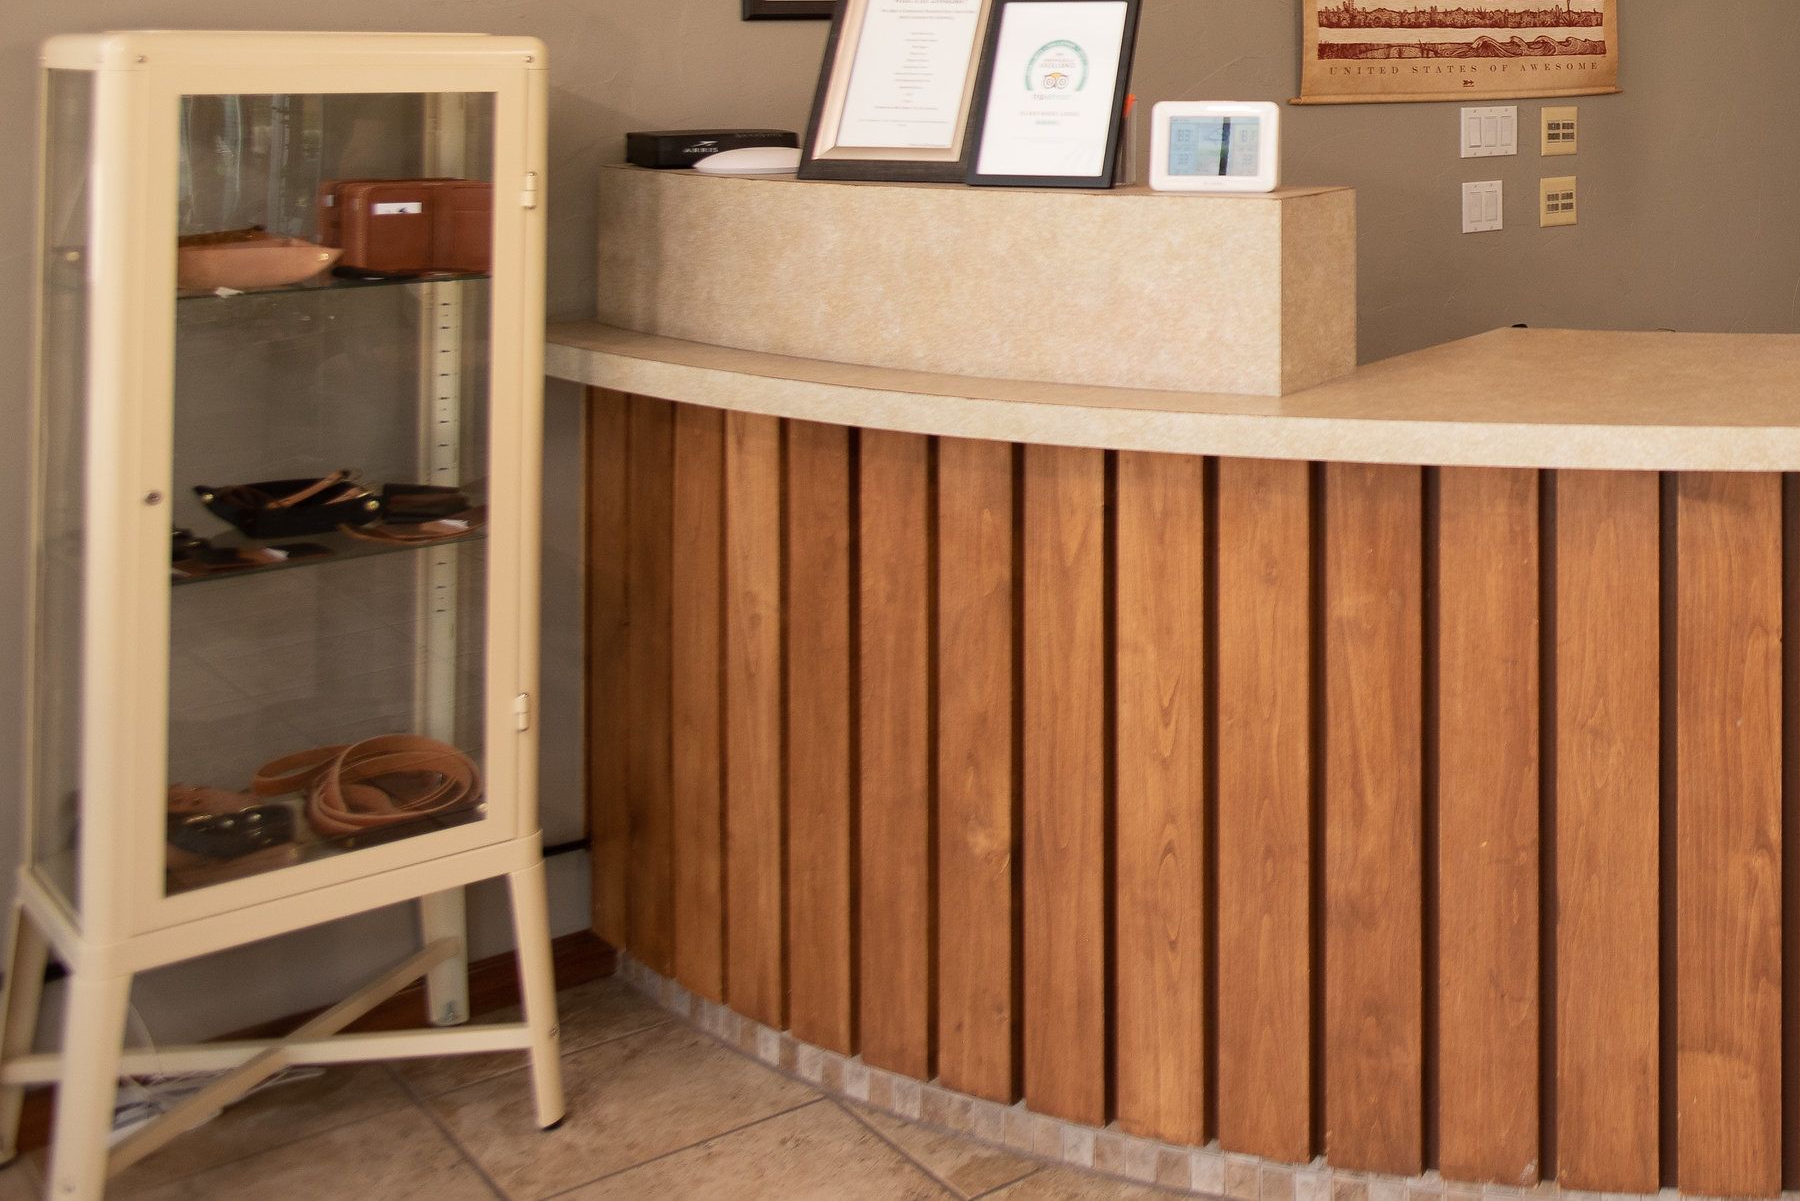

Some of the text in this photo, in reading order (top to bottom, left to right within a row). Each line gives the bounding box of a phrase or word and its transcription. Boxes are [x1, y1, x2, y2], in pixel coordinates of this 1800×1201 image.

[1330, 62, 1599, 75] UNITED STATES OF AWESOME
